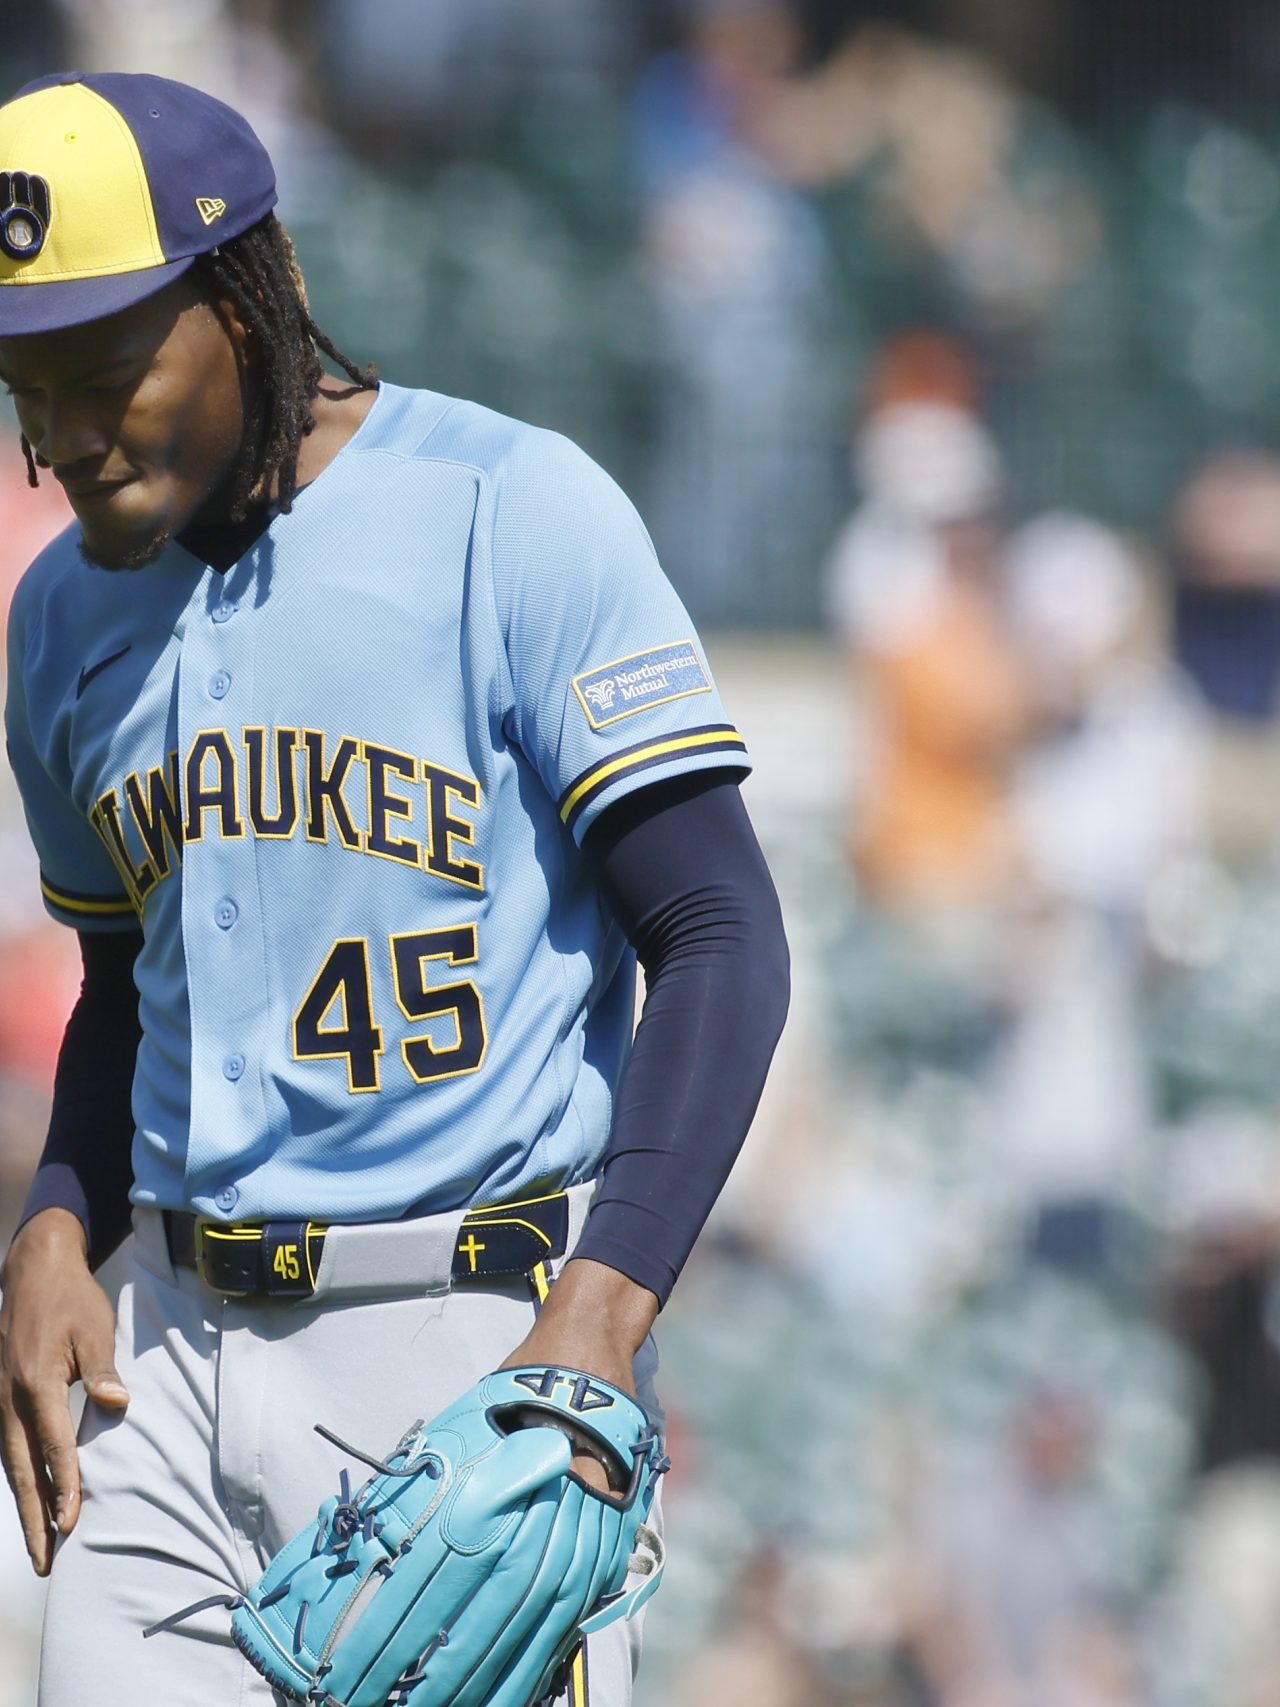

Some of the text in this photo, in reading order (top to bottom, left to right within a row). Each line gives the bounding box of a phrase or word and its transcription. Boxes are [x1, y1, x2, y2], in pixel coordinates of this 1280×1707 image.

[614, 655, 697, 687] Northwestern
[620, 673, 669, 700] Mutual
[89, 725, 485, 925] LWAUKEE
[292, 922, 488, 1094] 45
[273, 1244, 300, 1280] 45
